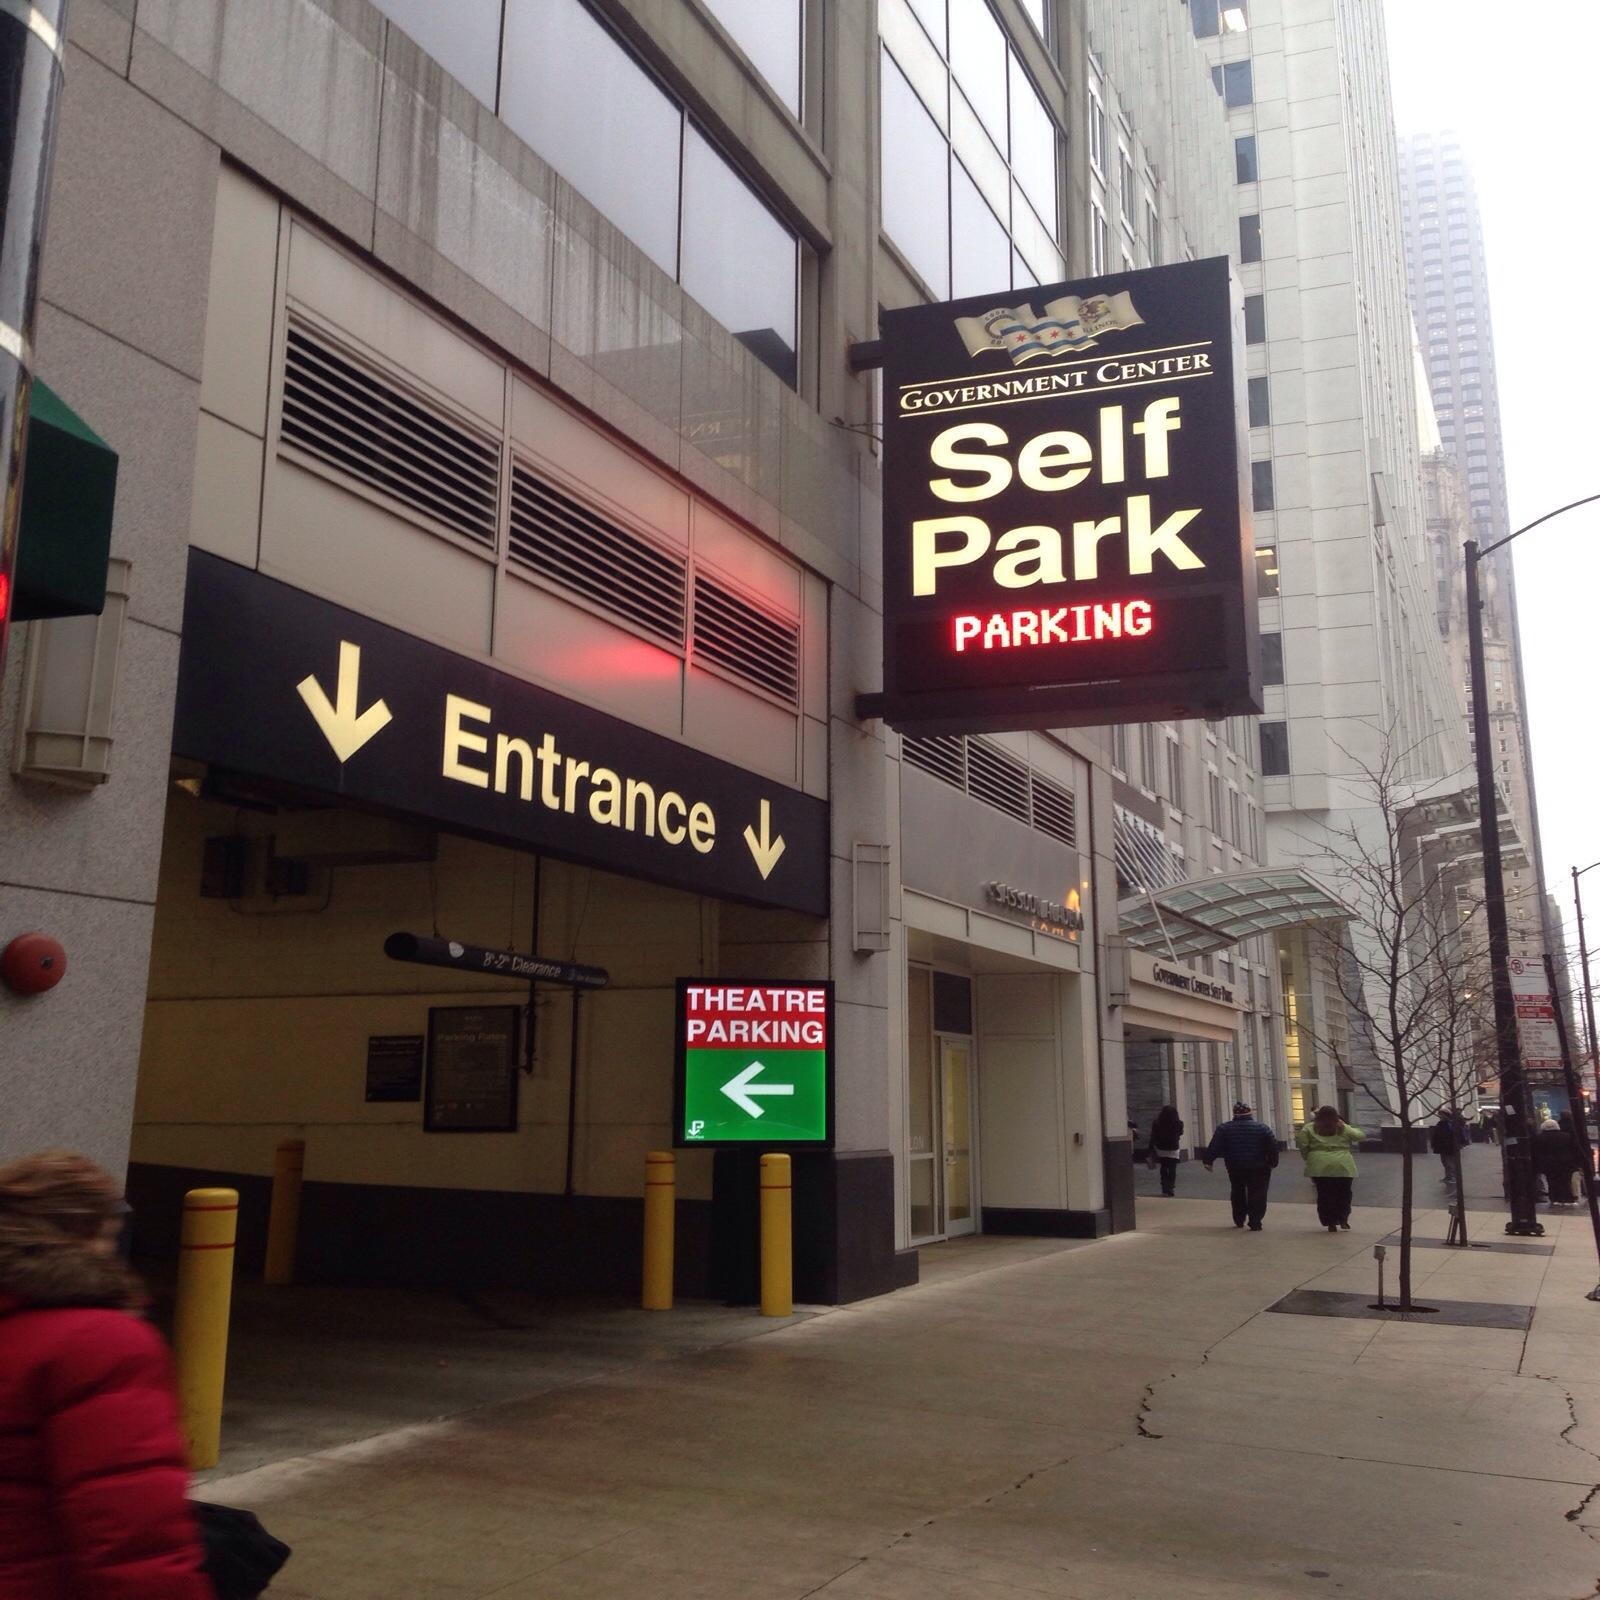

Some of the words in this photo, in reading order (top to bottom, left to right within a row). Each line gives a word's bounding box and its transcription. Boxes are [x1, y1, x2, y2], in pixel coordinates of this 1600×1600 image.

[900, 371, 1087, 410] GOVERNMENT
[1096, 353, 1211, 383] CENTER
[929, 397, 1181, 503] Self
[912, 494, 1206, 597] Park
[955, 600, 1153, 652] PARKING
[442, 693, 716, 854] Entrance
[512, 956, 562, 977] Clearance
[687, 988, 825, 1012] THEATRE
[687, 1020, 823, 1044] PARKING
